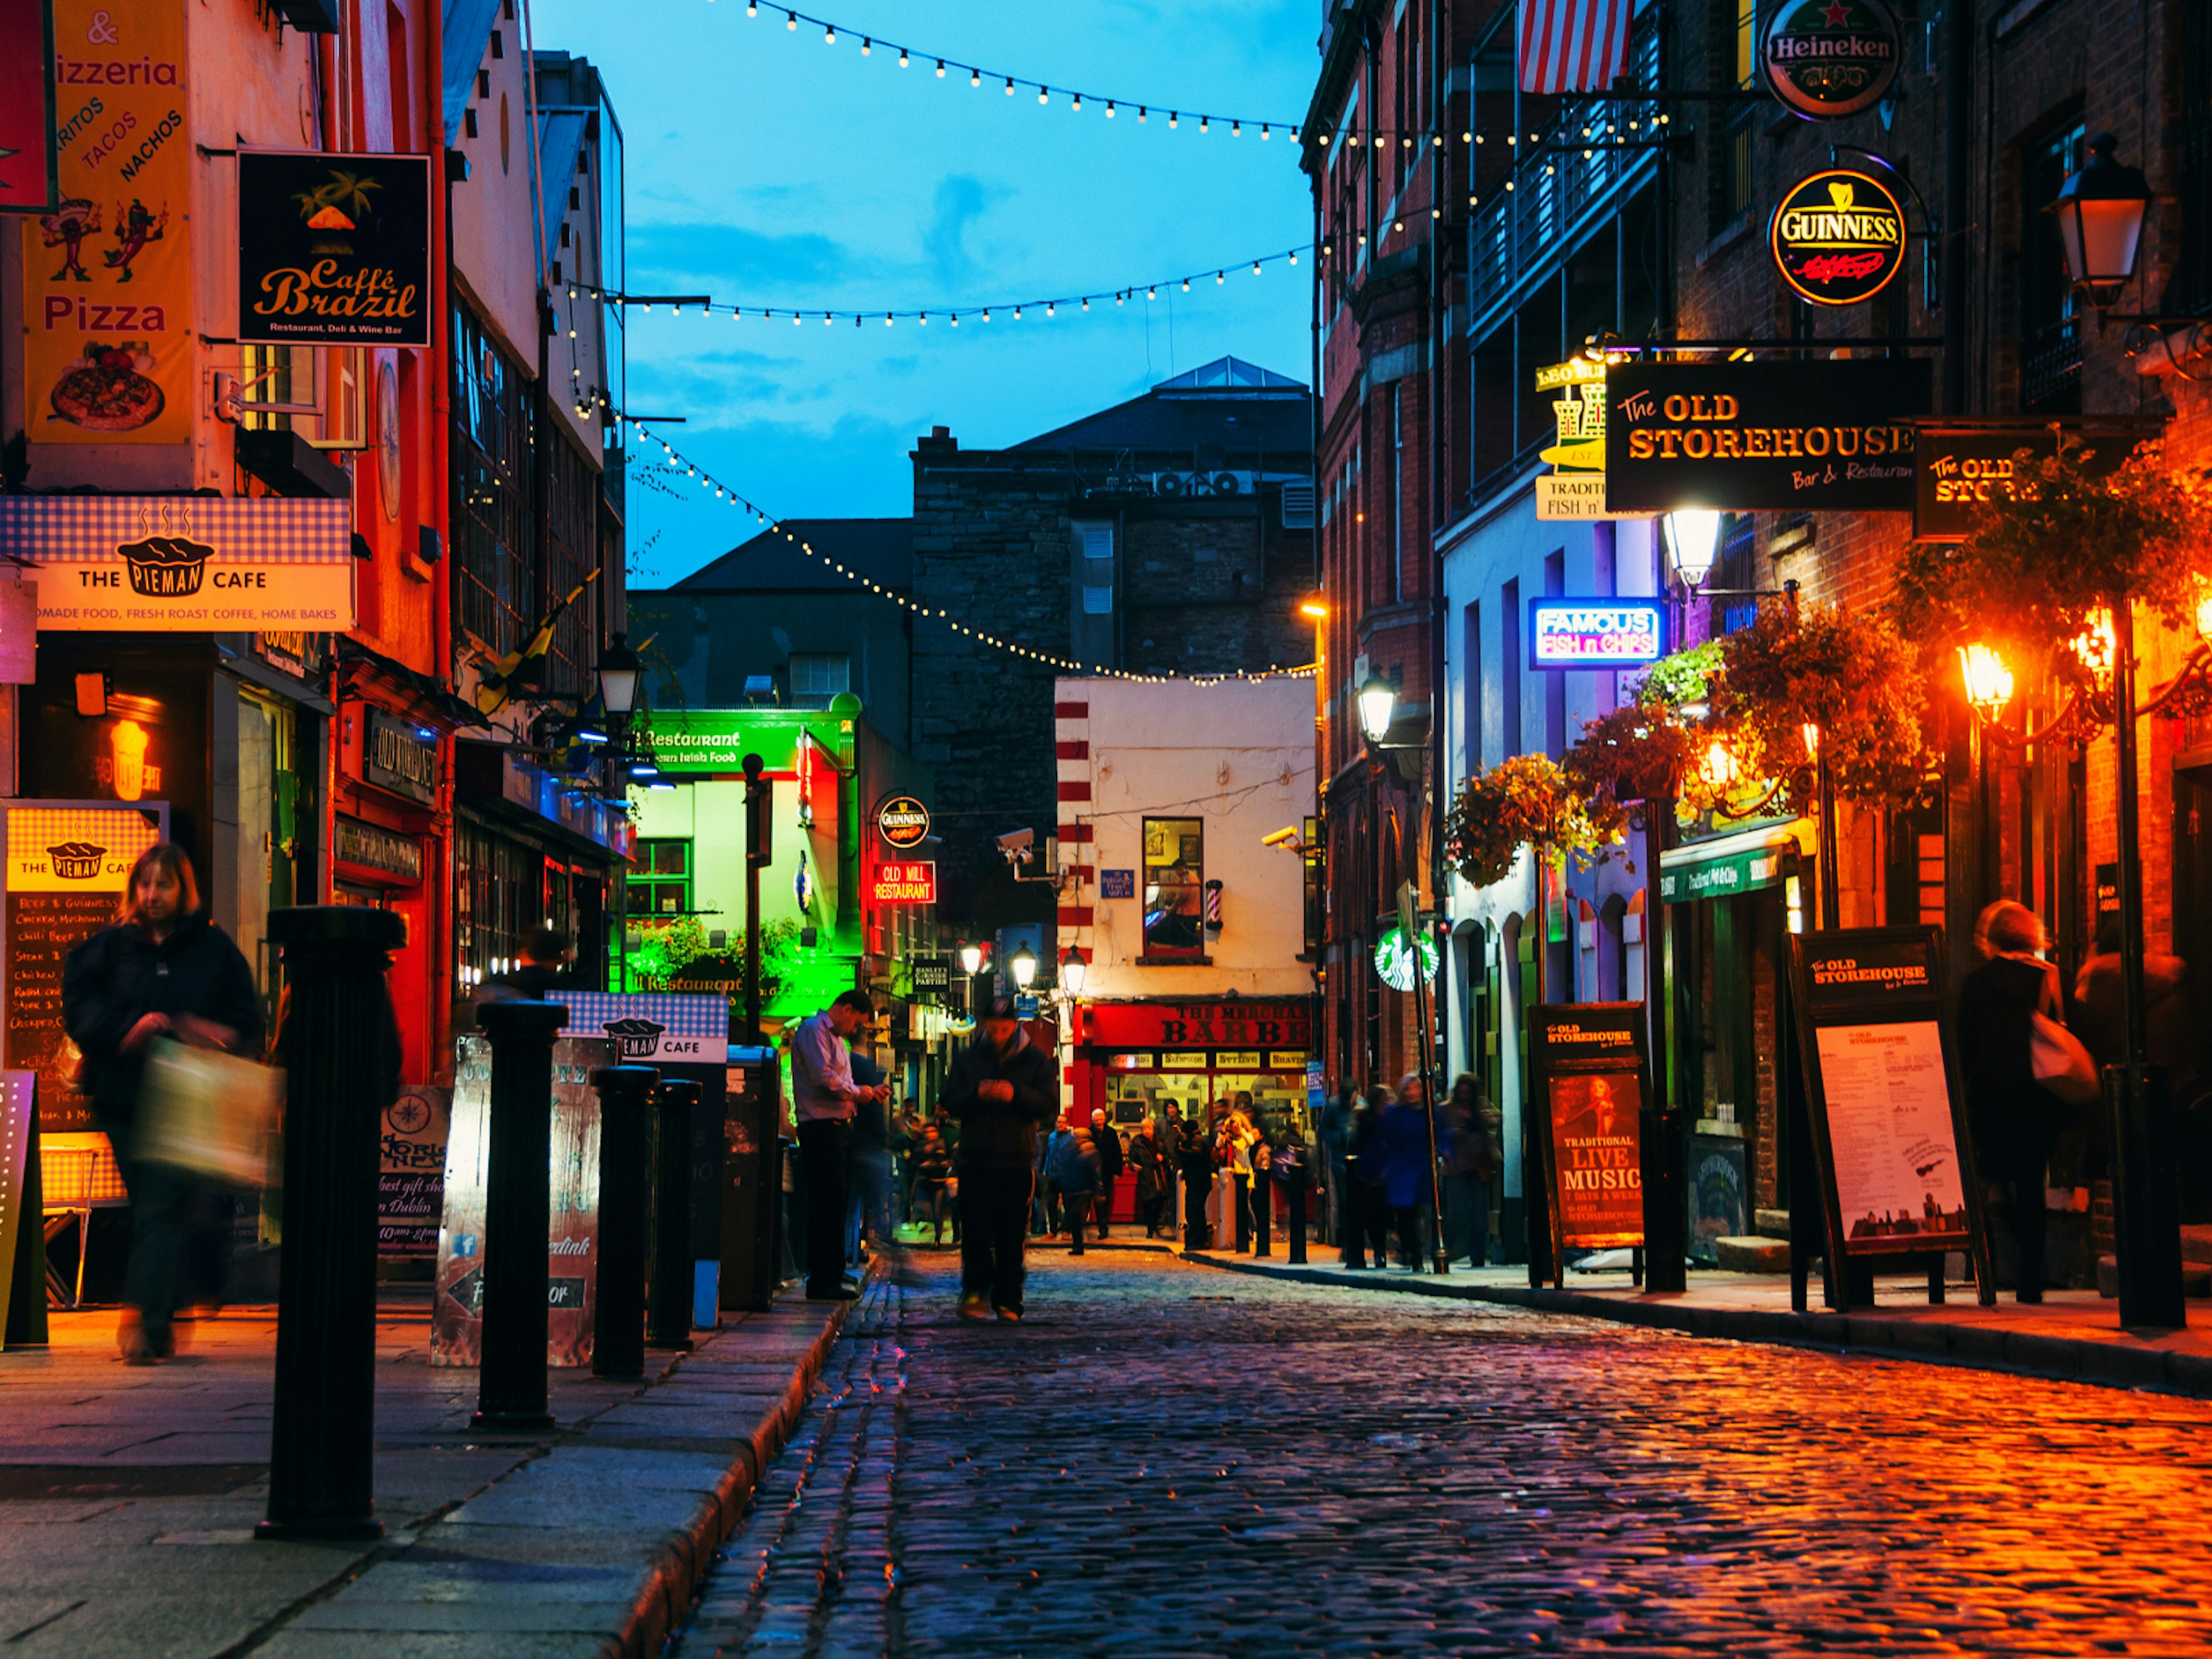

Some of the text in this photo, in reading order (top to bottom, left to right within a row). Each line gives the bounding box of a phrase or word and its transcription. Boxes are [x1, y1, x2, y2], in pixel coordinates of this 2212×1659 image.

[88, 11, 119, 44] &
[1777, 36, 1890, 59] Heineken
[56, 55, 176, 85] izzeria
[81, 111, 137, 169] TACOS
[120, 109, 181, 183] NACHOS
[1781, 212, 1896, 241] GUINNESS
[310, 259, 395, 296] Caffé
[253, 267, 416, 317] Brazil
[44, 296, 166, 331] Pizza
[270, 323, 325, 332] Restaurant,
[328, 324, 346, 332] Deli
[359, 325, 382, 334] Wine
[385, 326, 403, 334] Bar
[1537, 367, 1572, 387] LEO
[1617, 390, 1738, 422] The OLD
[1629, 427, 1914, 459] STOREHOUSE
[1572, 452, 1594, 461] EST.
[1930, 455, 2014, 478] The OLD
[1792, 471, 1819, 490] Bar
[1823, 464, 1838, 484] &
[1548, 500, 1580, 514] FISH
[79, 565, 266, 593] THE PIEMAN CAFE
[83, 609, 122, 620] FOOD,
[127, 609, 164, 619] FRESH
[169, 609, 208, 619] ROAST
[213, 609, 257, 621] COFFEE,
[262, 609, 297, 620] HOME
[300, 610, 337, 620] BAKES
[1542, 612, 1650, 633] FAMOUS
[1544, 635, 1653, 653] FISH n CHIPS
[645, 730, 740, 747] Restaurant
[710, 752, 736, 763] Food
[882, 813, 926, 825] GUINNESS
[21, 863, 47, 873] THE
[56, 859, 100, 877] PIEMAN
[883, 866, 900, 881] OLD
[876, 884, 930, 899] RESTAURANT
[1815, 965, 1925, 984] STOREHOUSE
[1827, 959, 1857, 971] OLD
[647, 977, 743, 991] Restaurant
[1177, 1007, 1214, 1018] THE
[1161, 1020, 1310, 1043] BARBE
[1548, 1031, 1631, 1043] STOREHOUSE
[1558, 1024, 1580, 1033] OLD
[664, 1042, 699, 1053] CAFE
[1565, 1136, 1634, 1147] TRADITIONAL
[1571, 1147, 1629, 1168] LIVE
[1563, 1168, 1641, 1190] MUSIC
[402, 1177, 424, 1206] gift
[1574, 1191, 1599, 1201] DAYS
[1602, 1192, 1610, 1200] A
[1612, 1191, 1642, 1200] WEEK
[388, 1196, 431, 1214] Dublin
